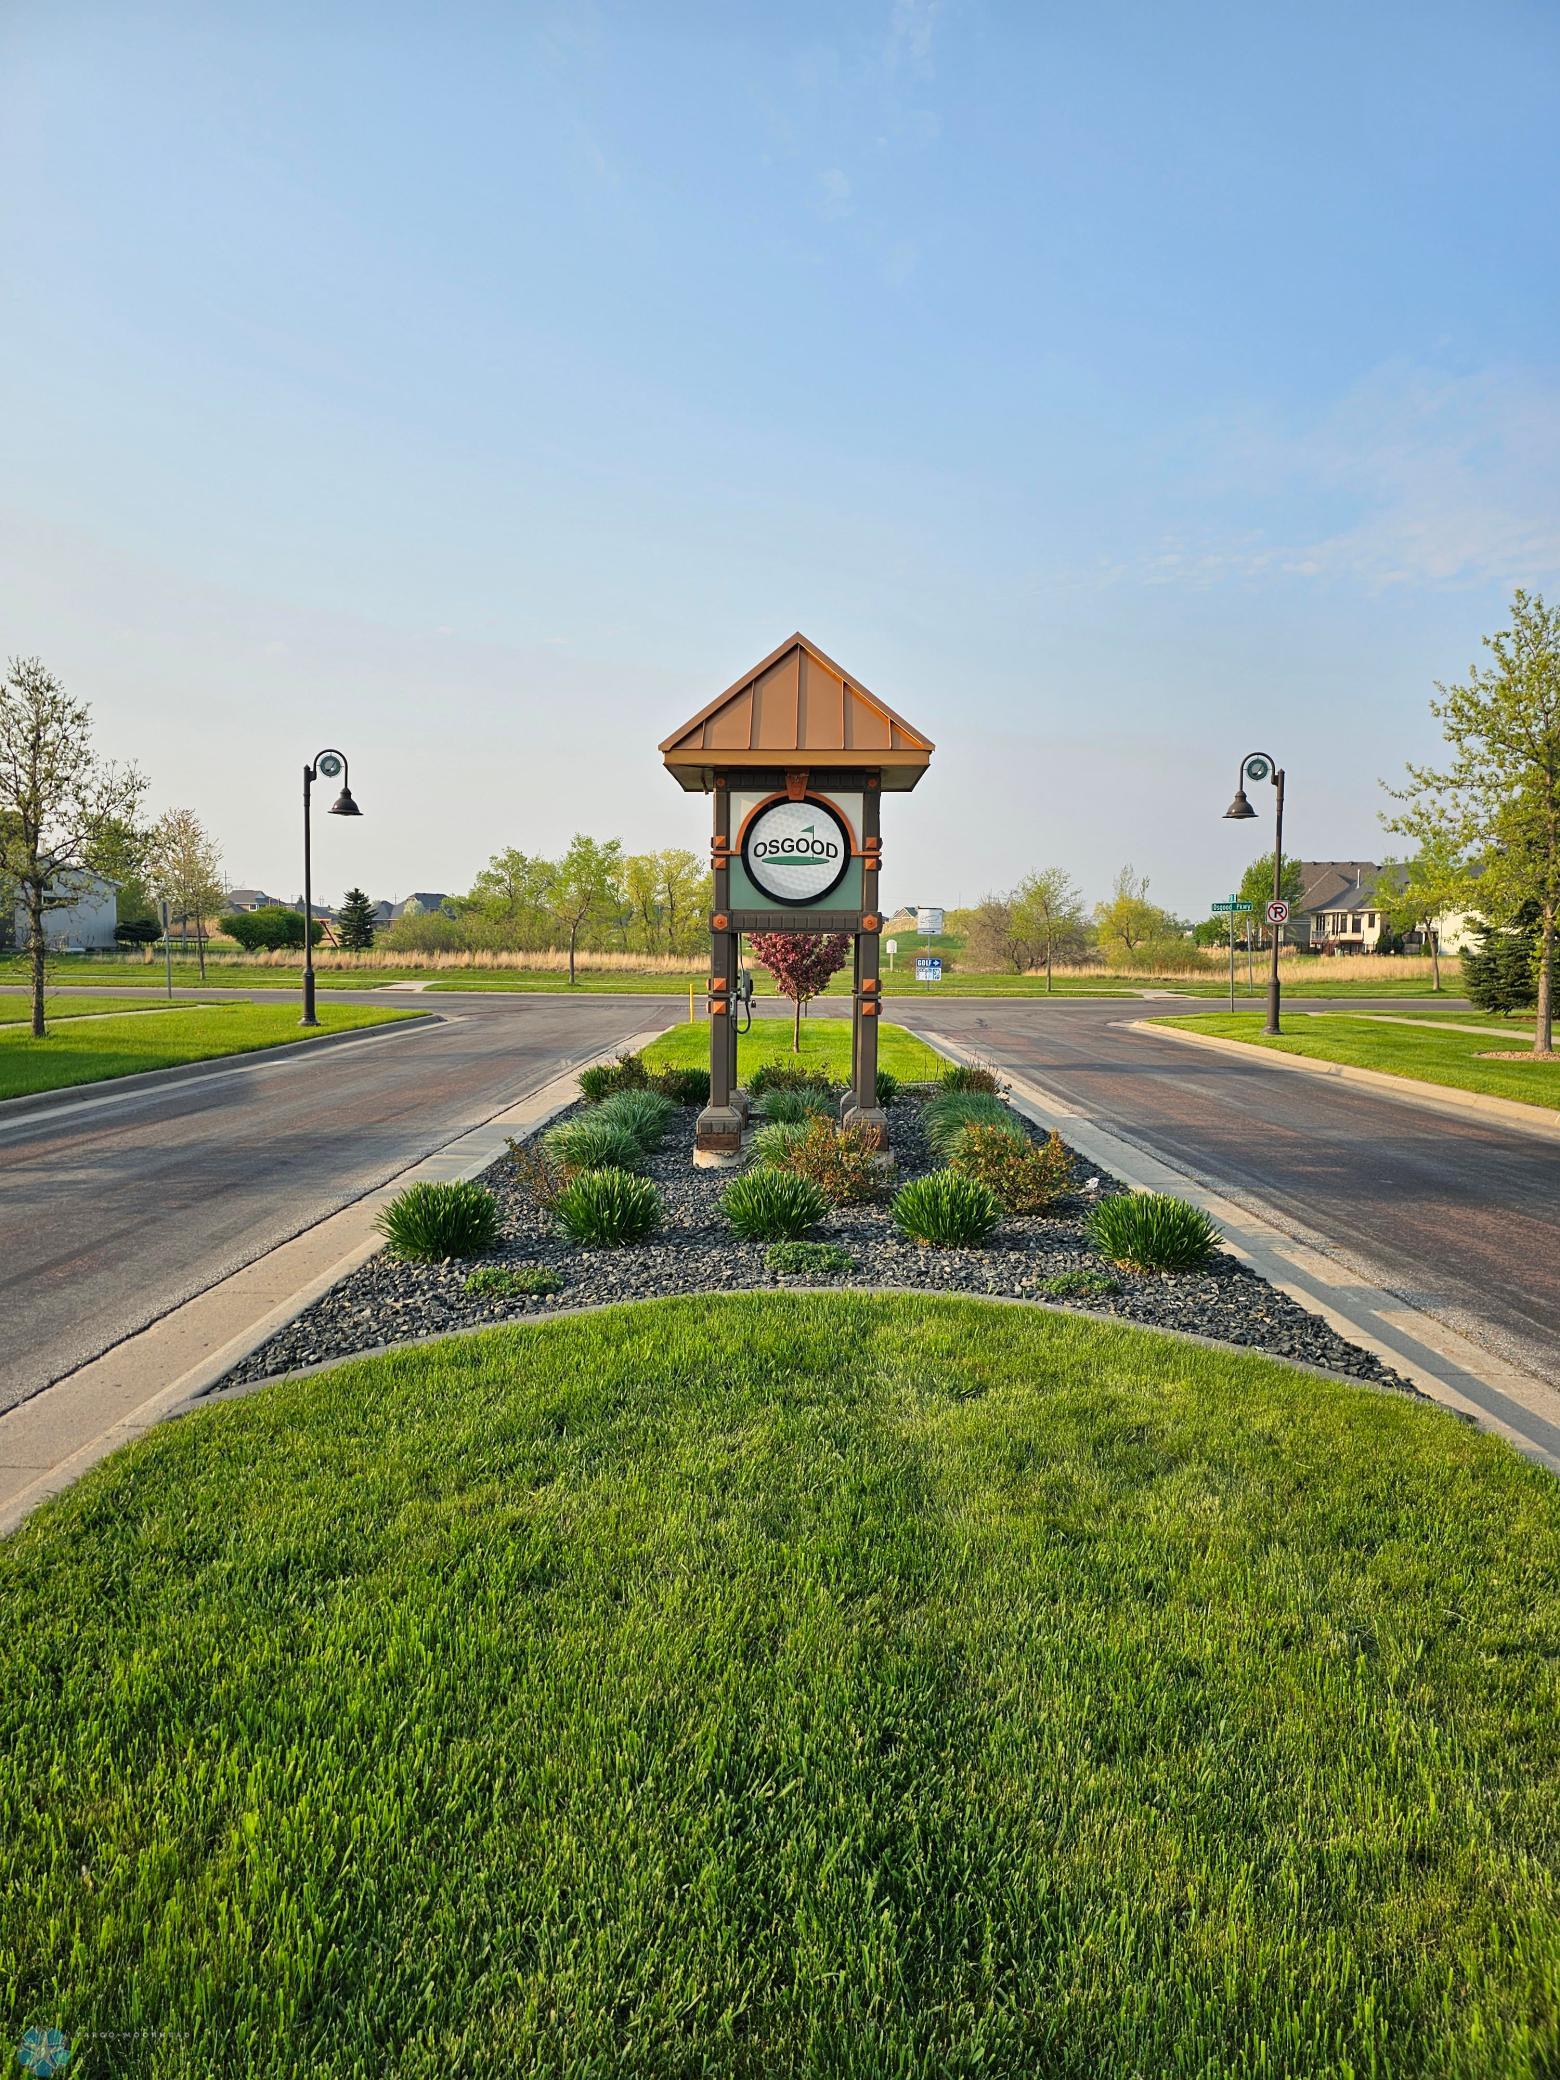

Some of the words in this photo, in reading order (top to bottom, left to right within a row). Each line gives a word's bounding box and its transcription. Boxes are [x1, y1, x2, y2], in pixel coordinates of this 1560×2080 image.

[753, 837, 839, 859] OSGOOD
[1213, 903, 1233, 911] Osgood
[1236, 903, 1251, 911] Pkwy
[1274, 906, 1284, 918] P
[917, 959, 933, 967] GOLF
